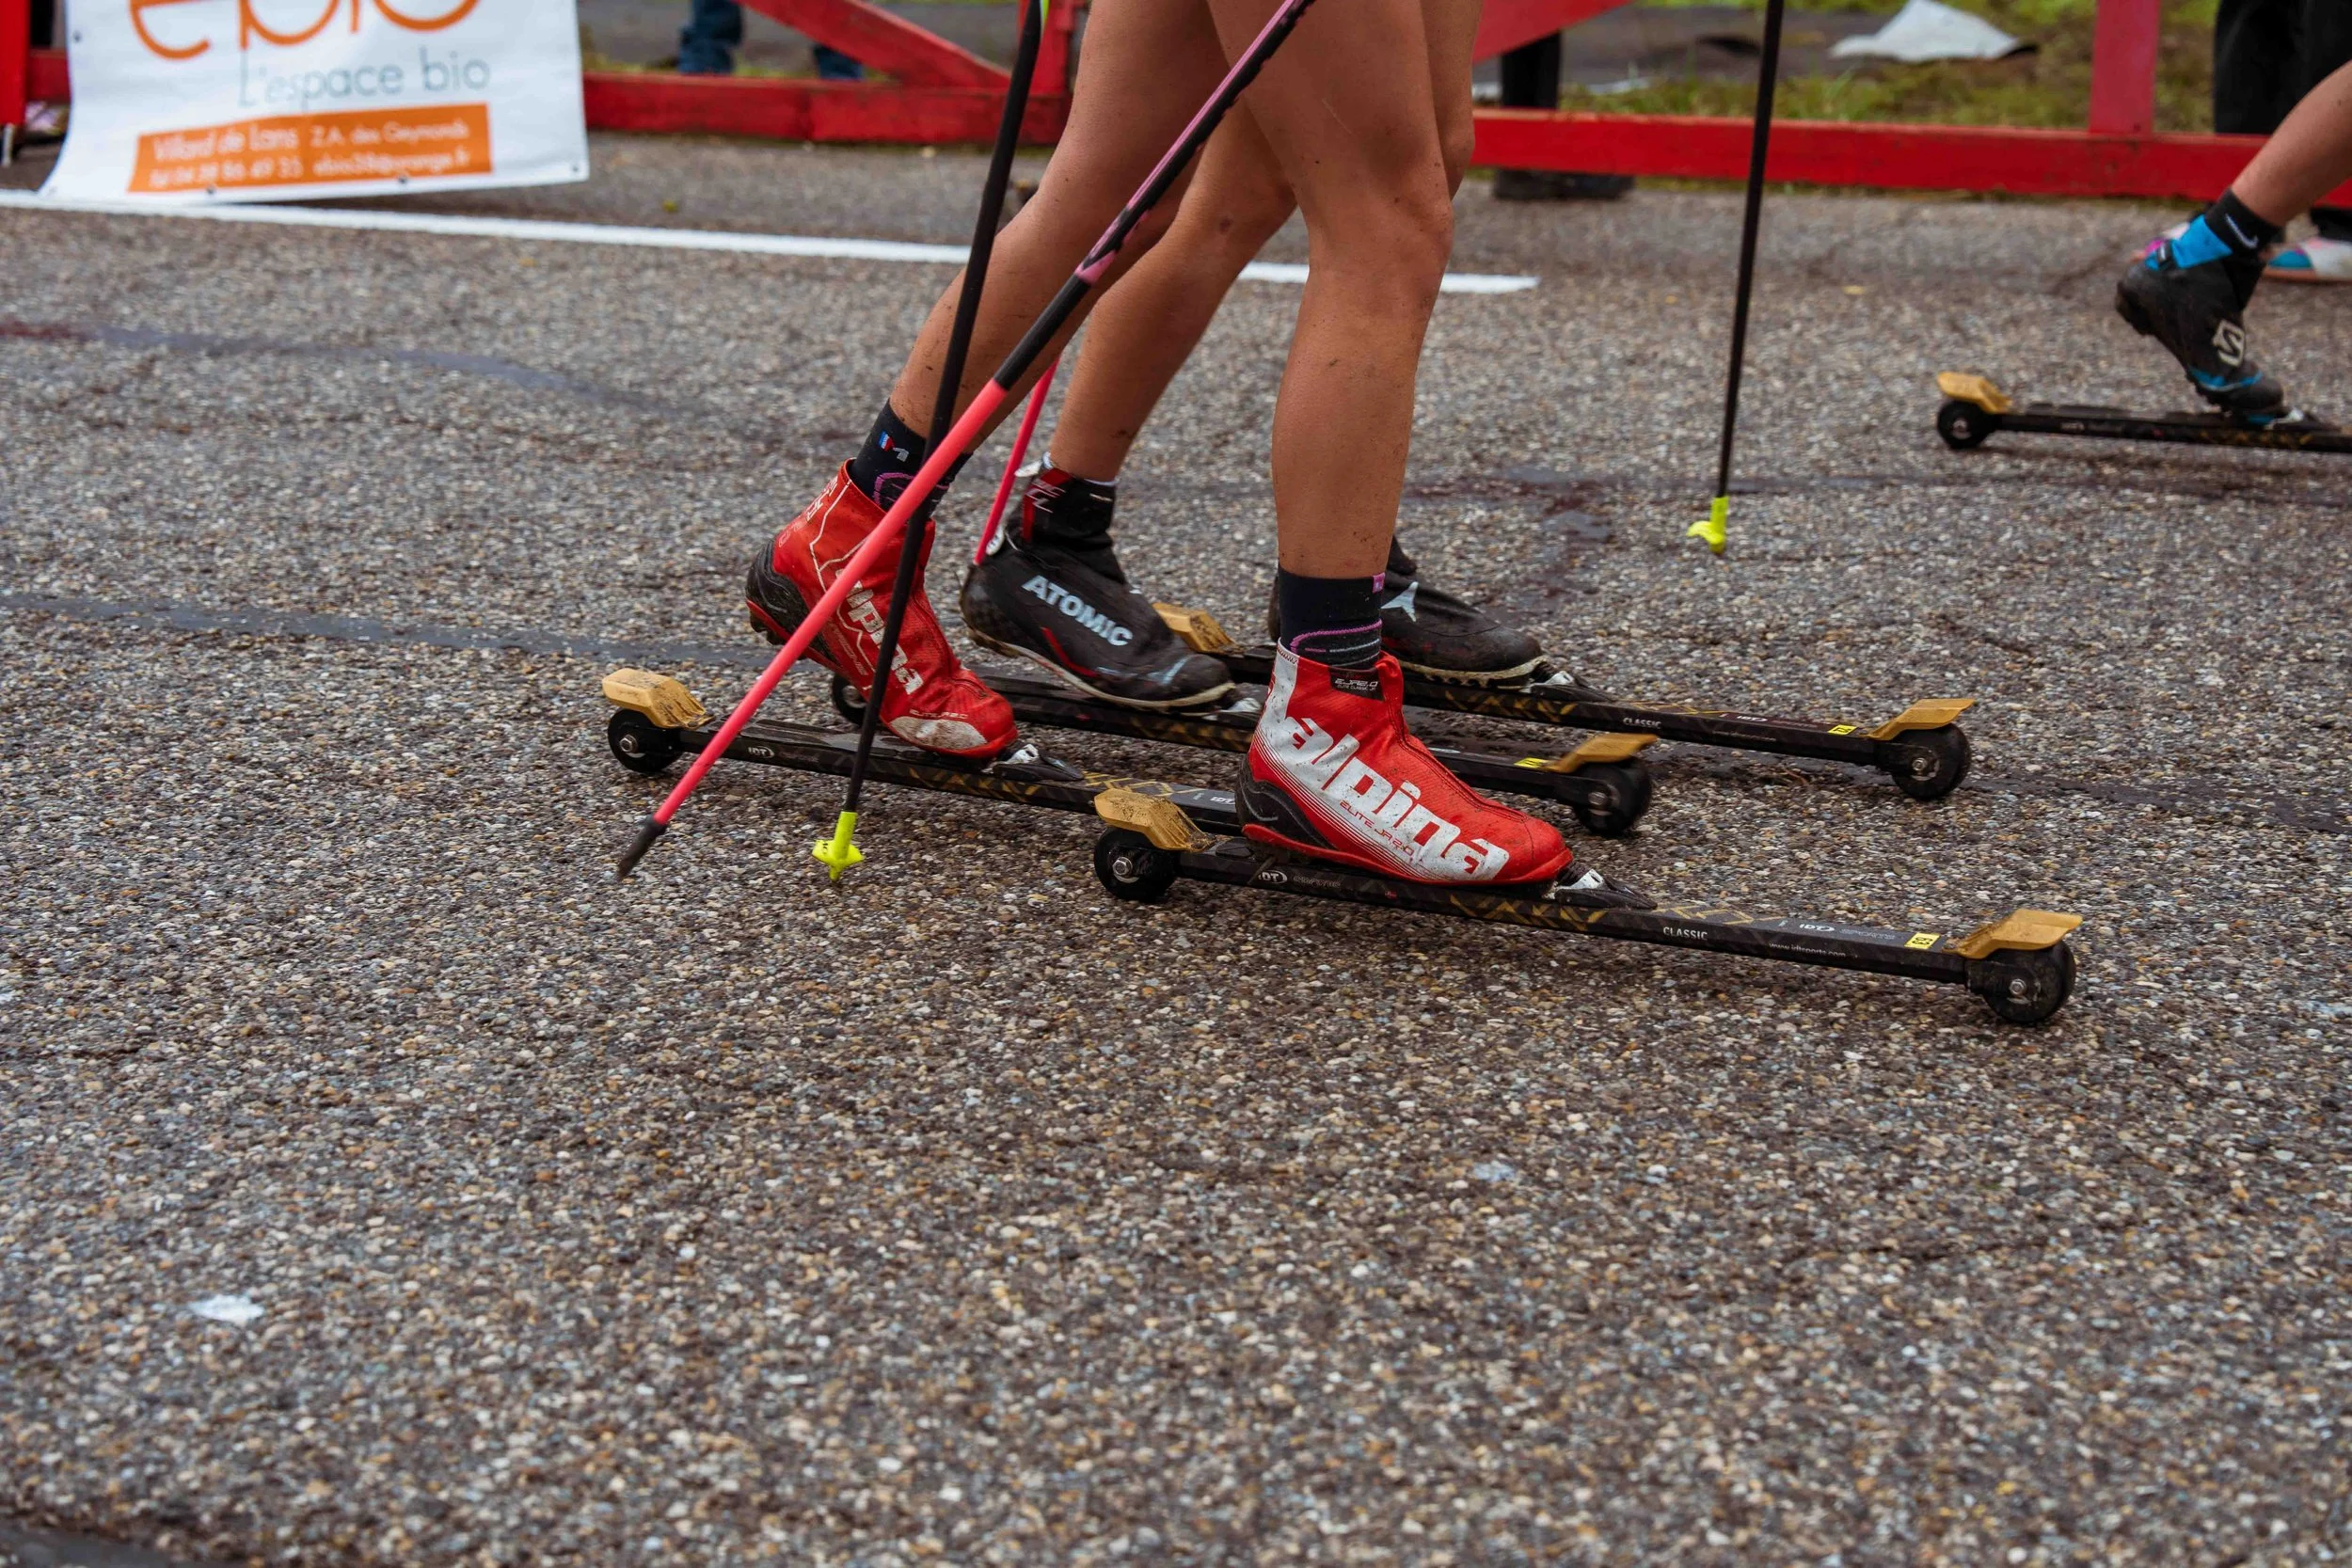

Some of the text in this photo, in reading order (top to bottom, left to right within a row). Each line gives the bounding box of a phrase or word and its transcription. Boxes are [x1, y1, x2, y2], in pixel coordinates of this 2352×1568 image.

[238, 46, 491, 111] L'espace bio
[1022, 575, 1134, 646] ATOMIC
[1622, 717, 1662, 730] CLASSIC
[1272, 715, 1510, 881] alpina
[1340, 800, 1375, 829] ELITE
[1662, 926, 1708, 941] CLASSIC
